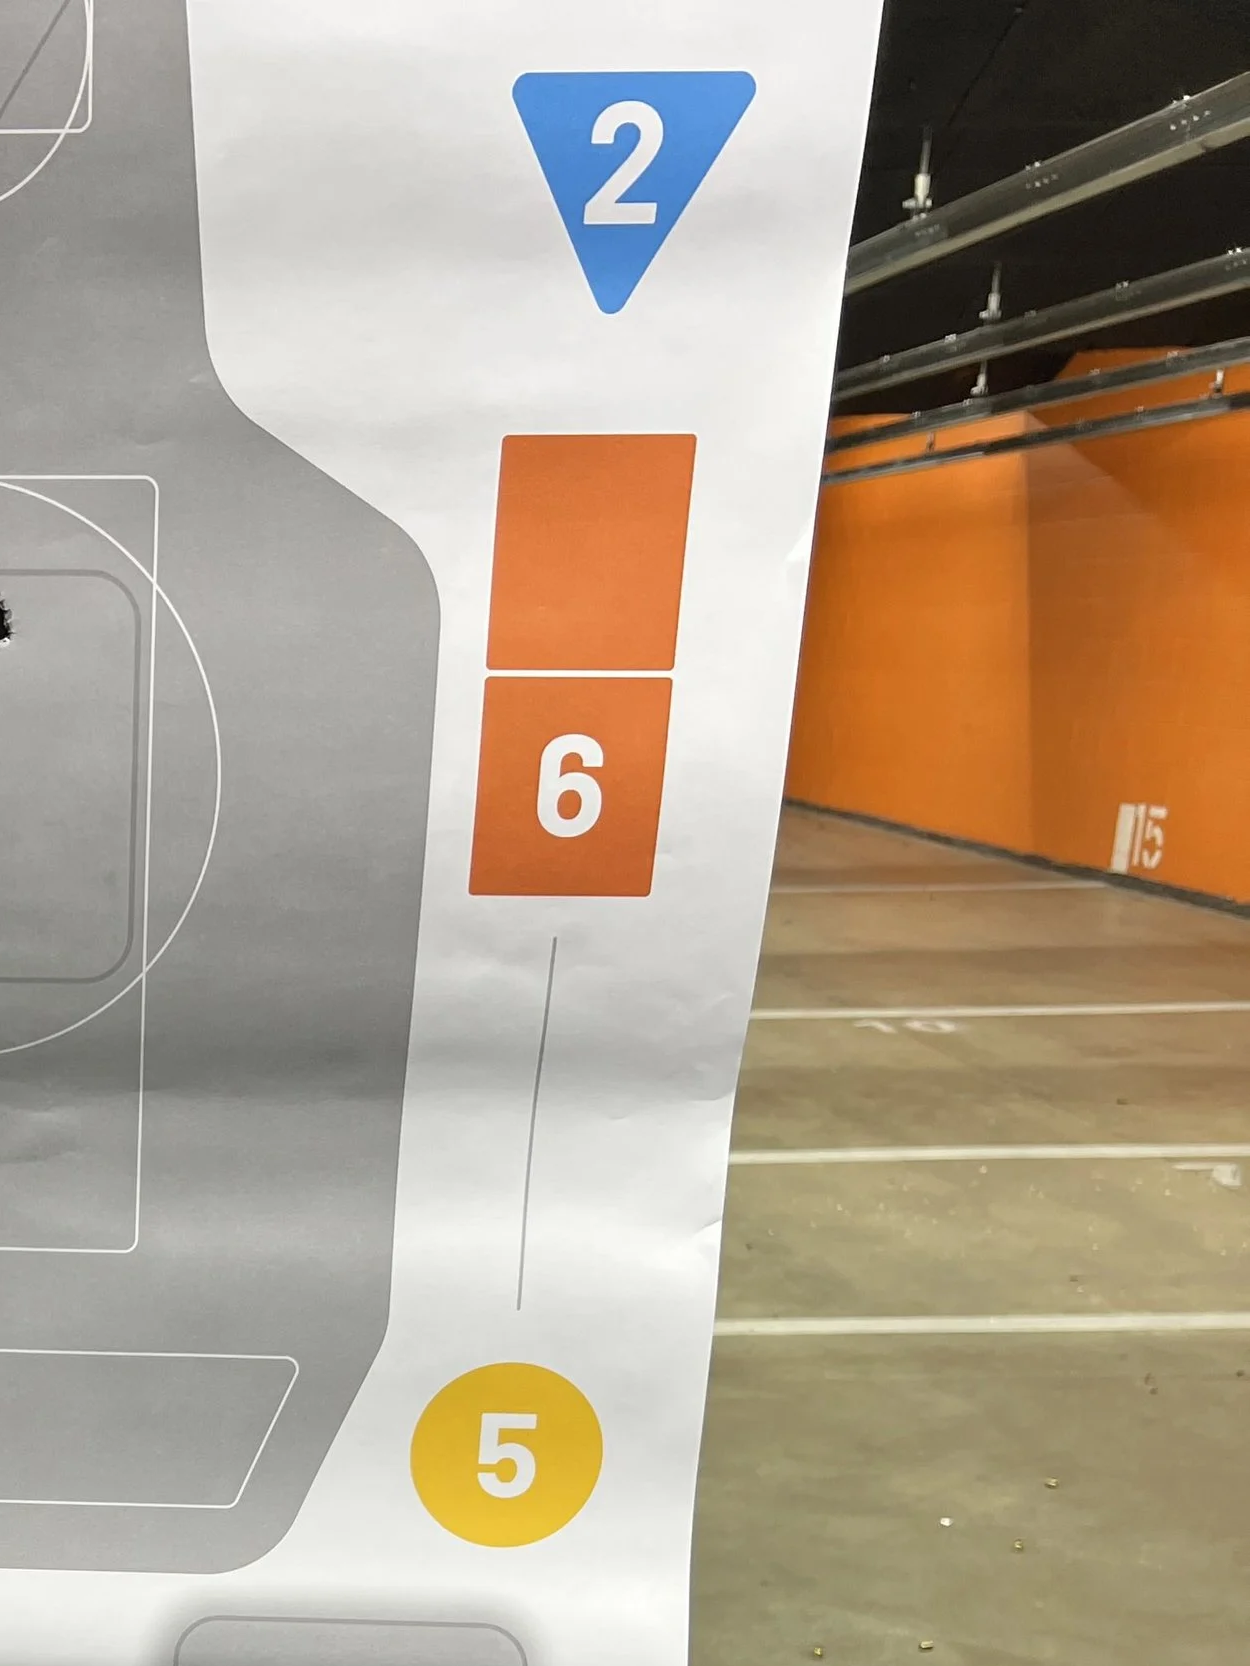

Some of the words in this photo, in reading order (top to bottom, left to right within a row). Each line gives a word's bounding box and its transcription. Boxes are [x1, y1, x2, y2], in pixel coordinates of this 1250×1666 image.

[583, 100, 664, 225] 2
[536, 733, 604, 838] 6
[477, 1412, 538, 1499] 5
